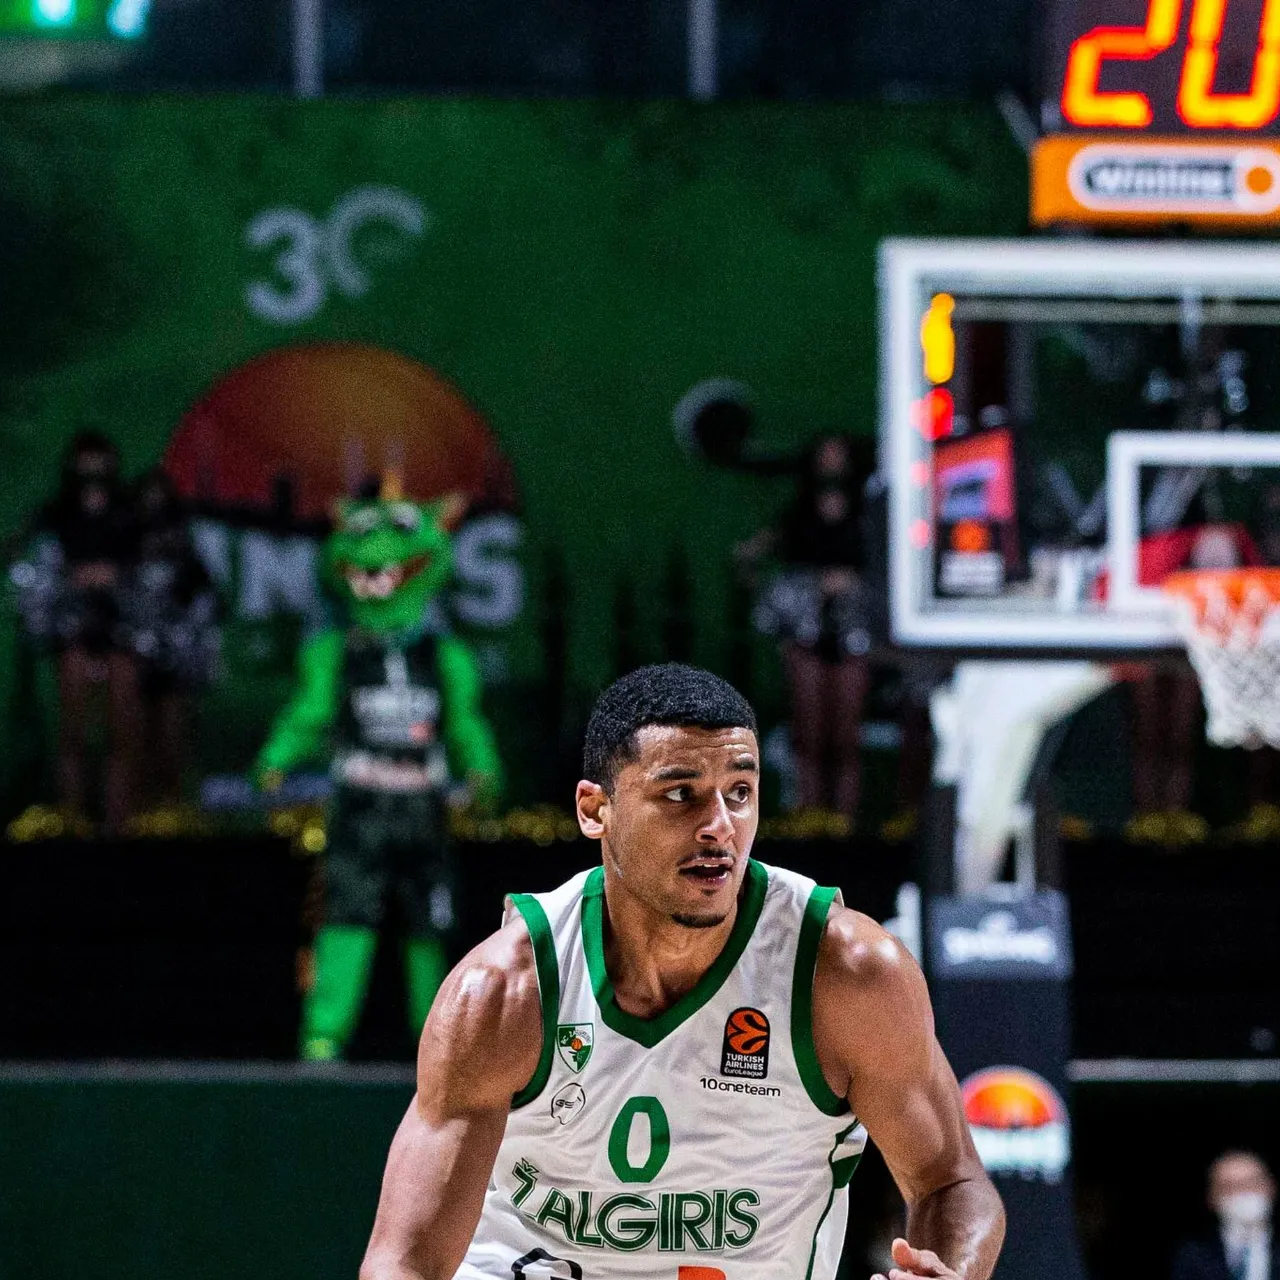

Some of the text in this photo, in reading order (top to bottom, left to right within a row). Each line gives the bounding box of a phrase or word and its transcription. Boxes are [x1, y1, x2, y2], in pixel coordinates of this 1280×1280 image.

[726, 1053, 765, 1064] TURKISH
[725, 1061, 764, 1071] AIRLINES
[608, 1096, 671, 1183] 0
